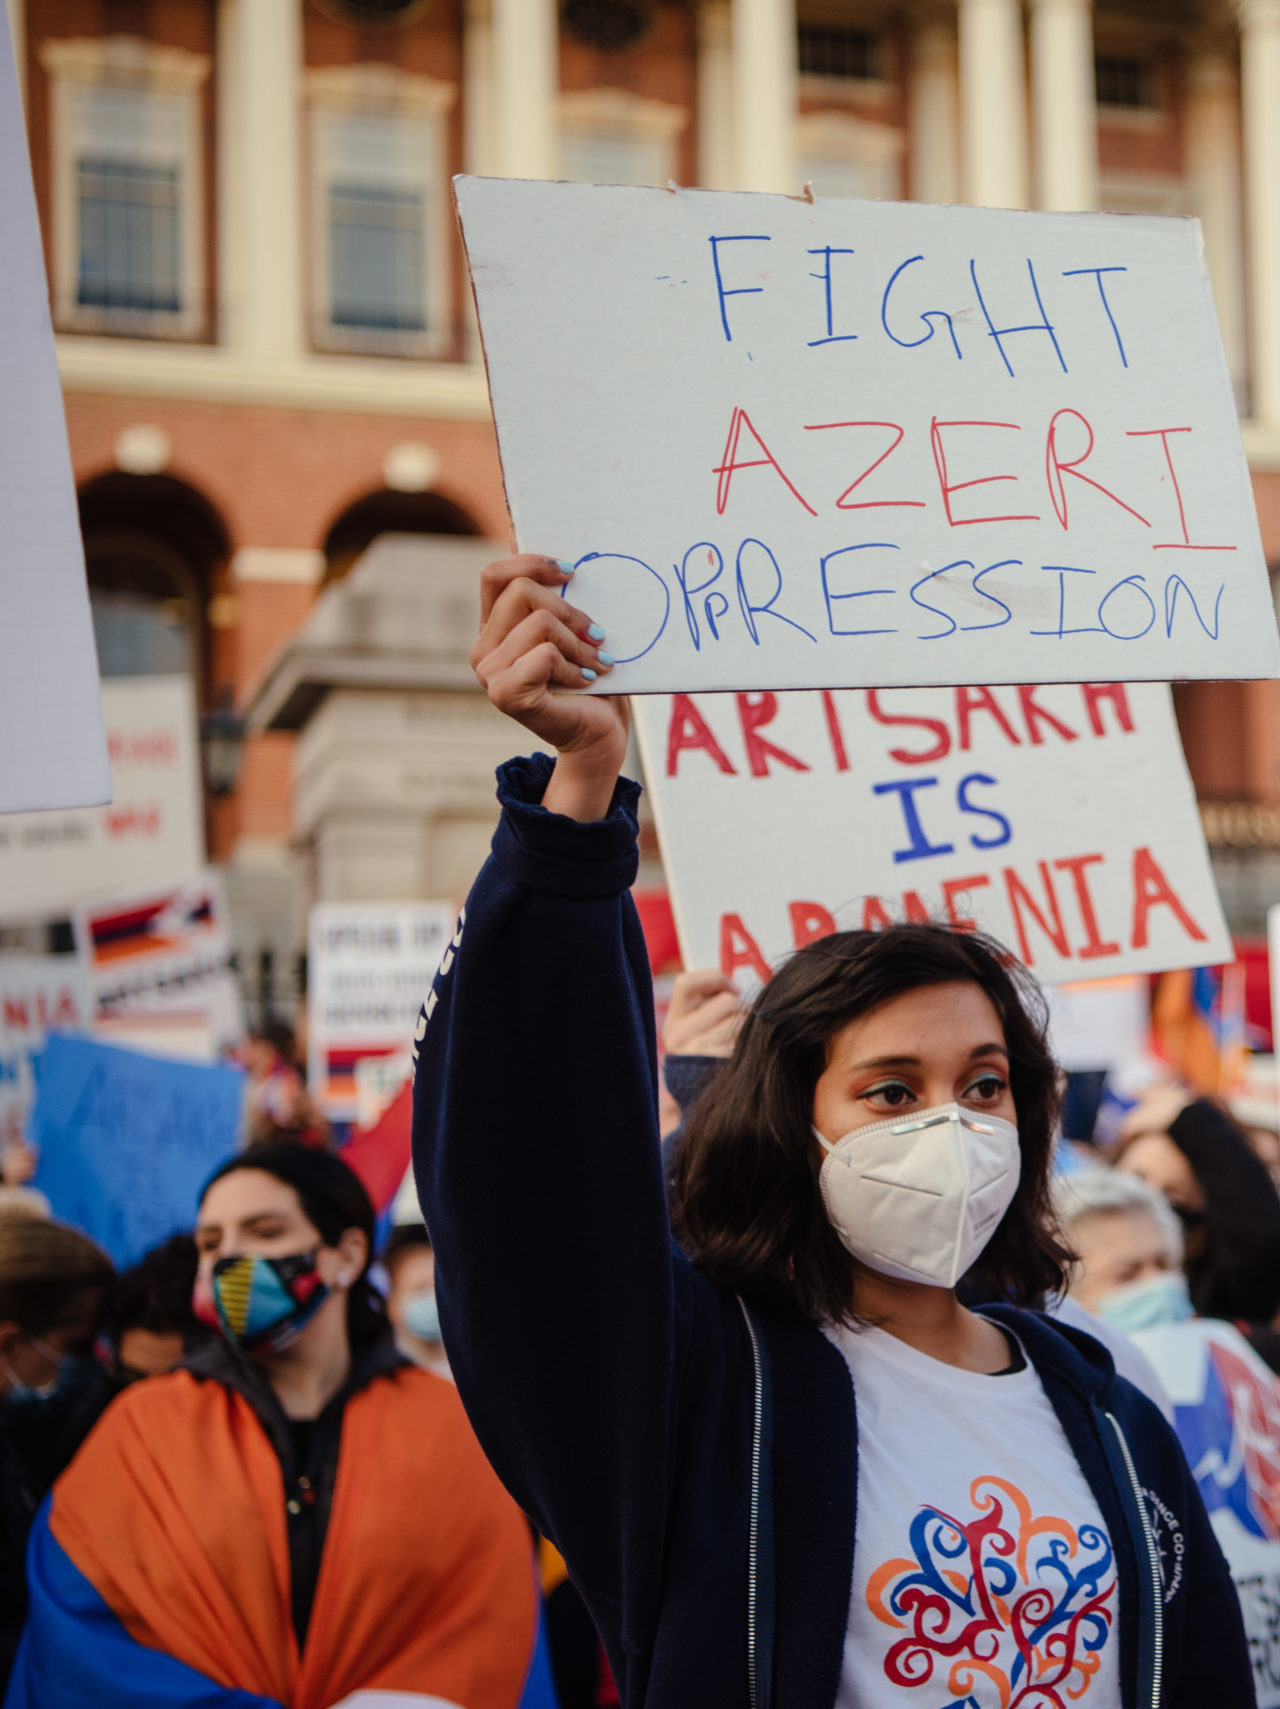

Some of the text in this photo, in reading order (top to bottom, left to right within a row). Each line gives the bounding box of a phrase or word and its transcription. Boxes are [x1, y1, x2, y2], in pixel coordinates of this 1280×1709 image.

[708, 235, 1129, 378] FIGHT
[711, 406, 1238, 551] AZERI
[872, 772, 1012, 864] IS
